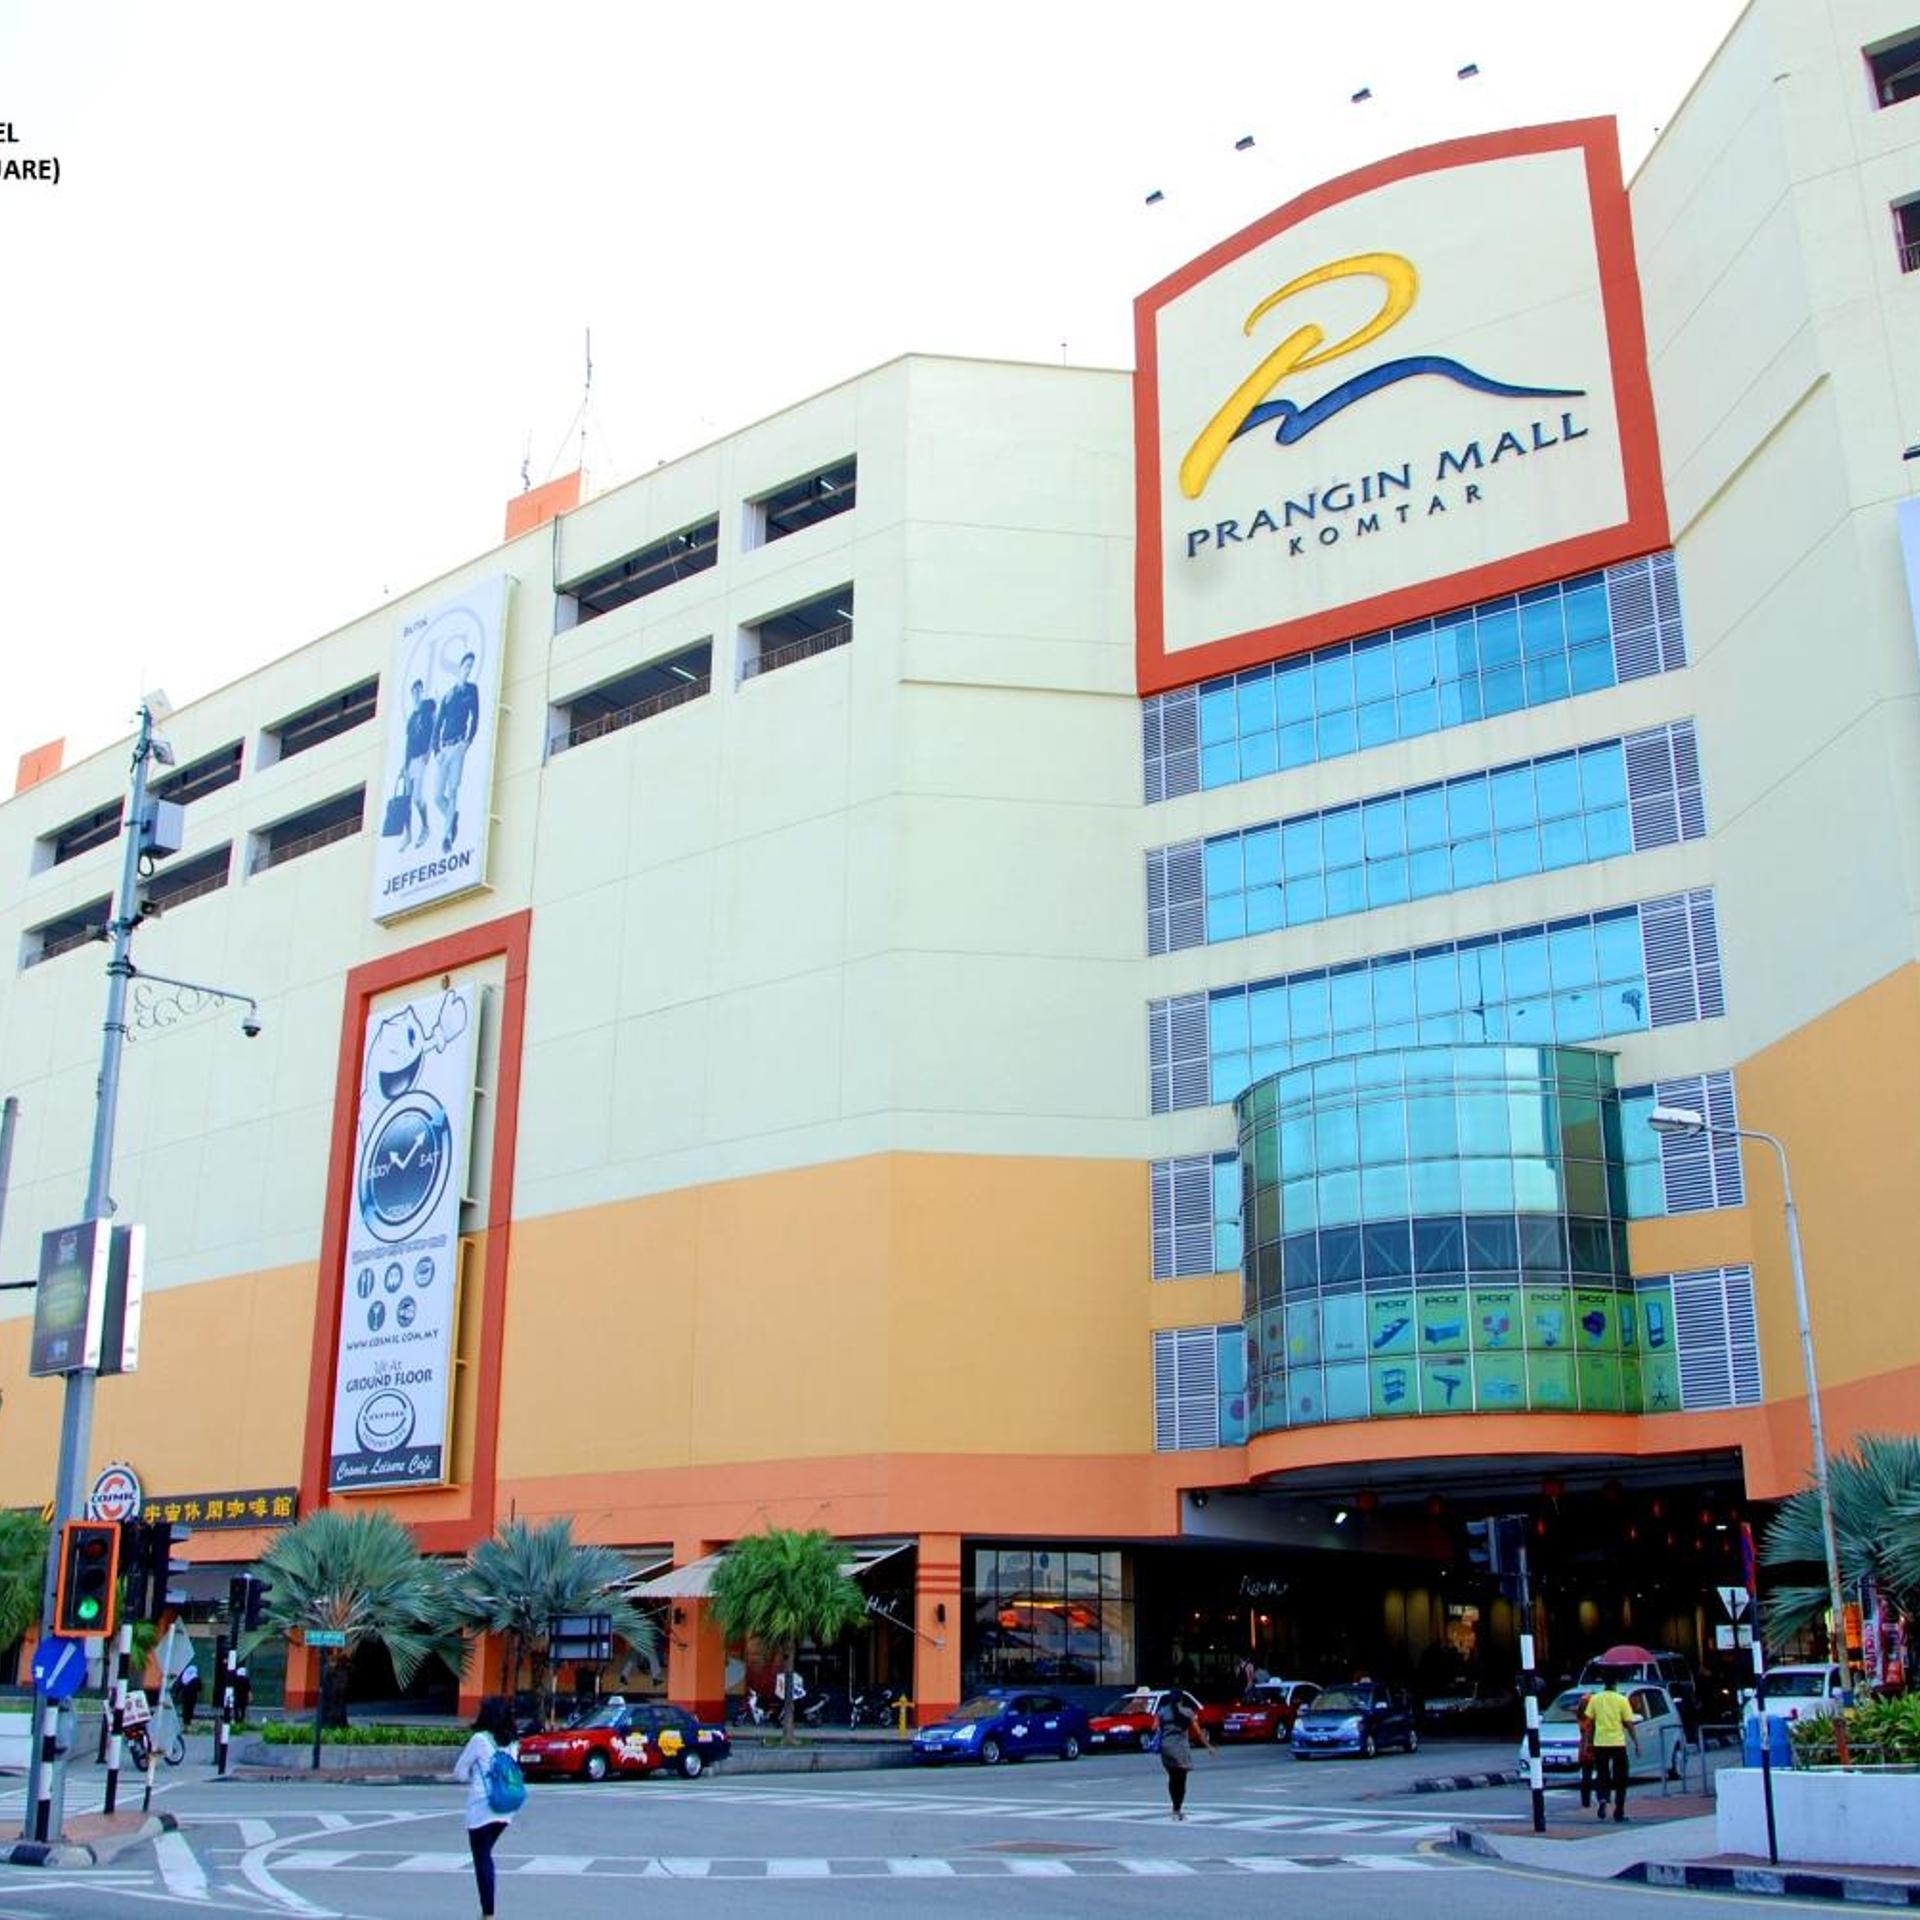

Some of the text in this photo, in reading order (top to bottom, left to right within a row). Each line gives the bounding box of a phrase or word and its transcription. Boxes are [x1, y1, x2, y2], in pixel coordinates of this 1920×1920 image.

[1186, 412, 1589, 558] PRANGIN MALL
[1289, 484, 1483, 557] KOMTAR
[383, 850, 470, 895] JEFFERSON
[346, 1368, 433, 1393] GROUND FLOOR
